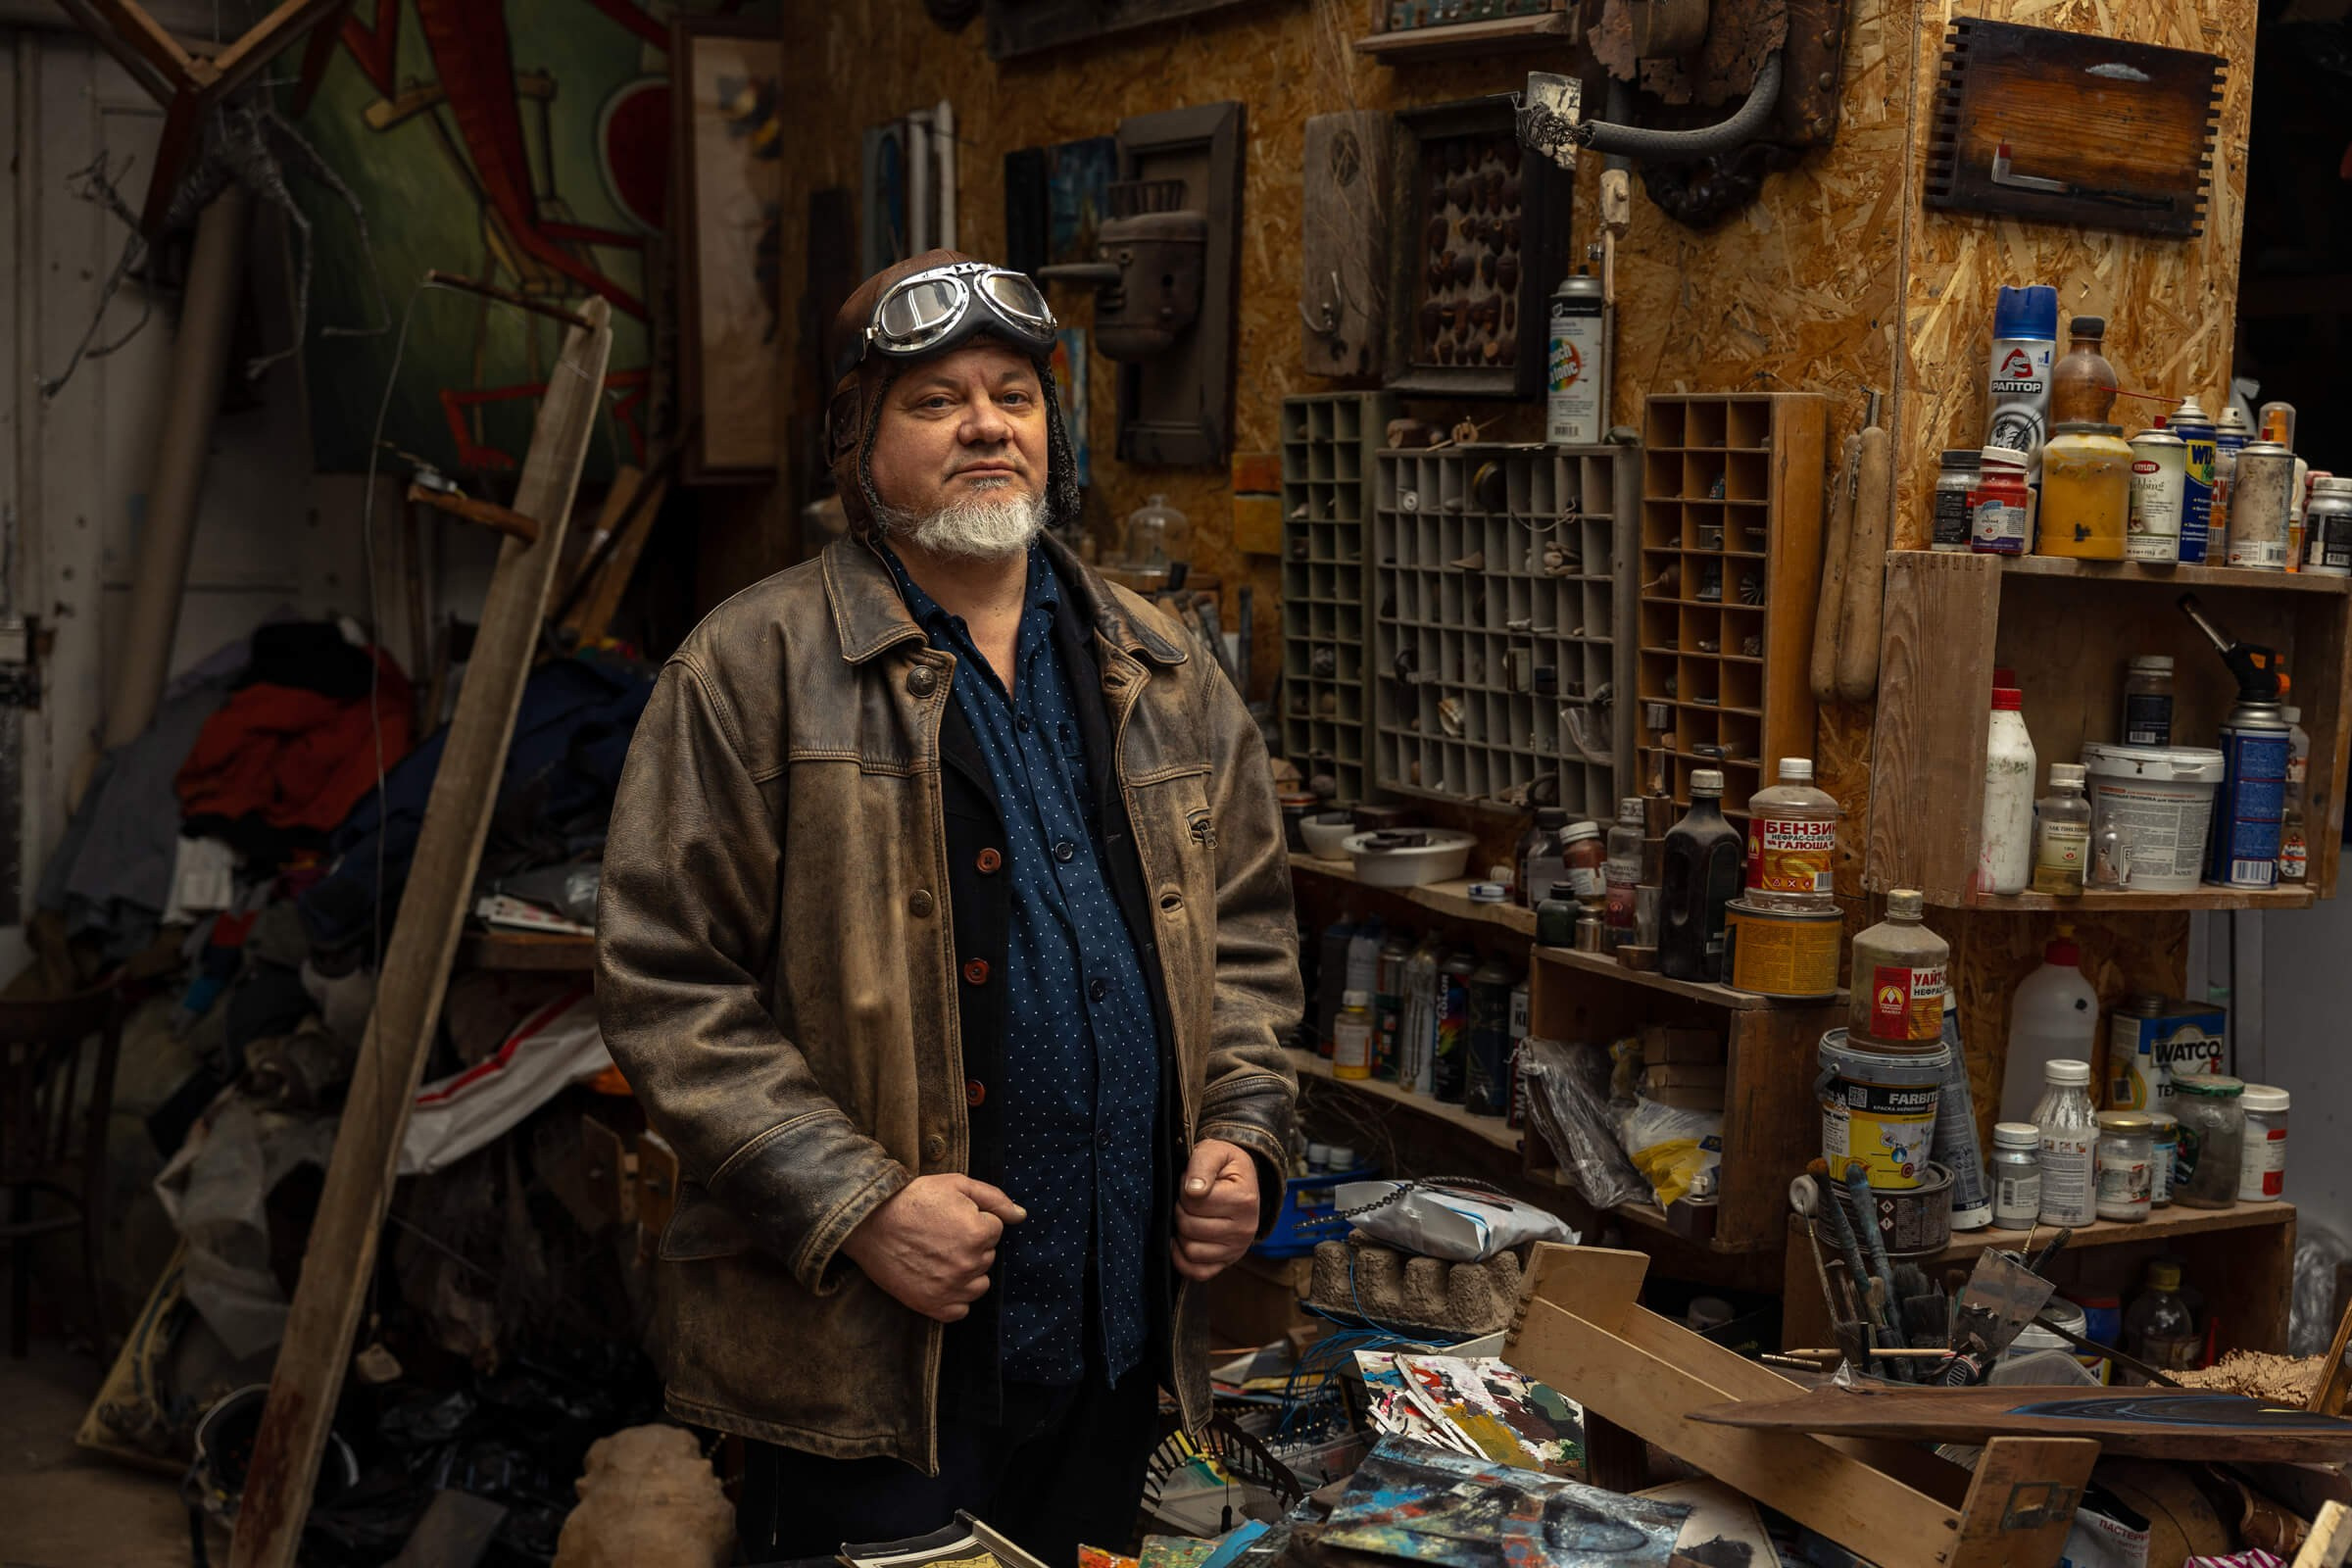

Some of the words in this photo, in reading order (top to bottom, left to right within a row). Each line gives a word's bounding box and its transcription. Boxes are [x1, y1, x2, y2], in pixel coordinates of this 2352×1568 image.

[1992, 381, 2041, 392] РАПТОР
[2155, 1041, 2220, 1062] WATCO
[2157, 1084, 2174, 1098] TE
